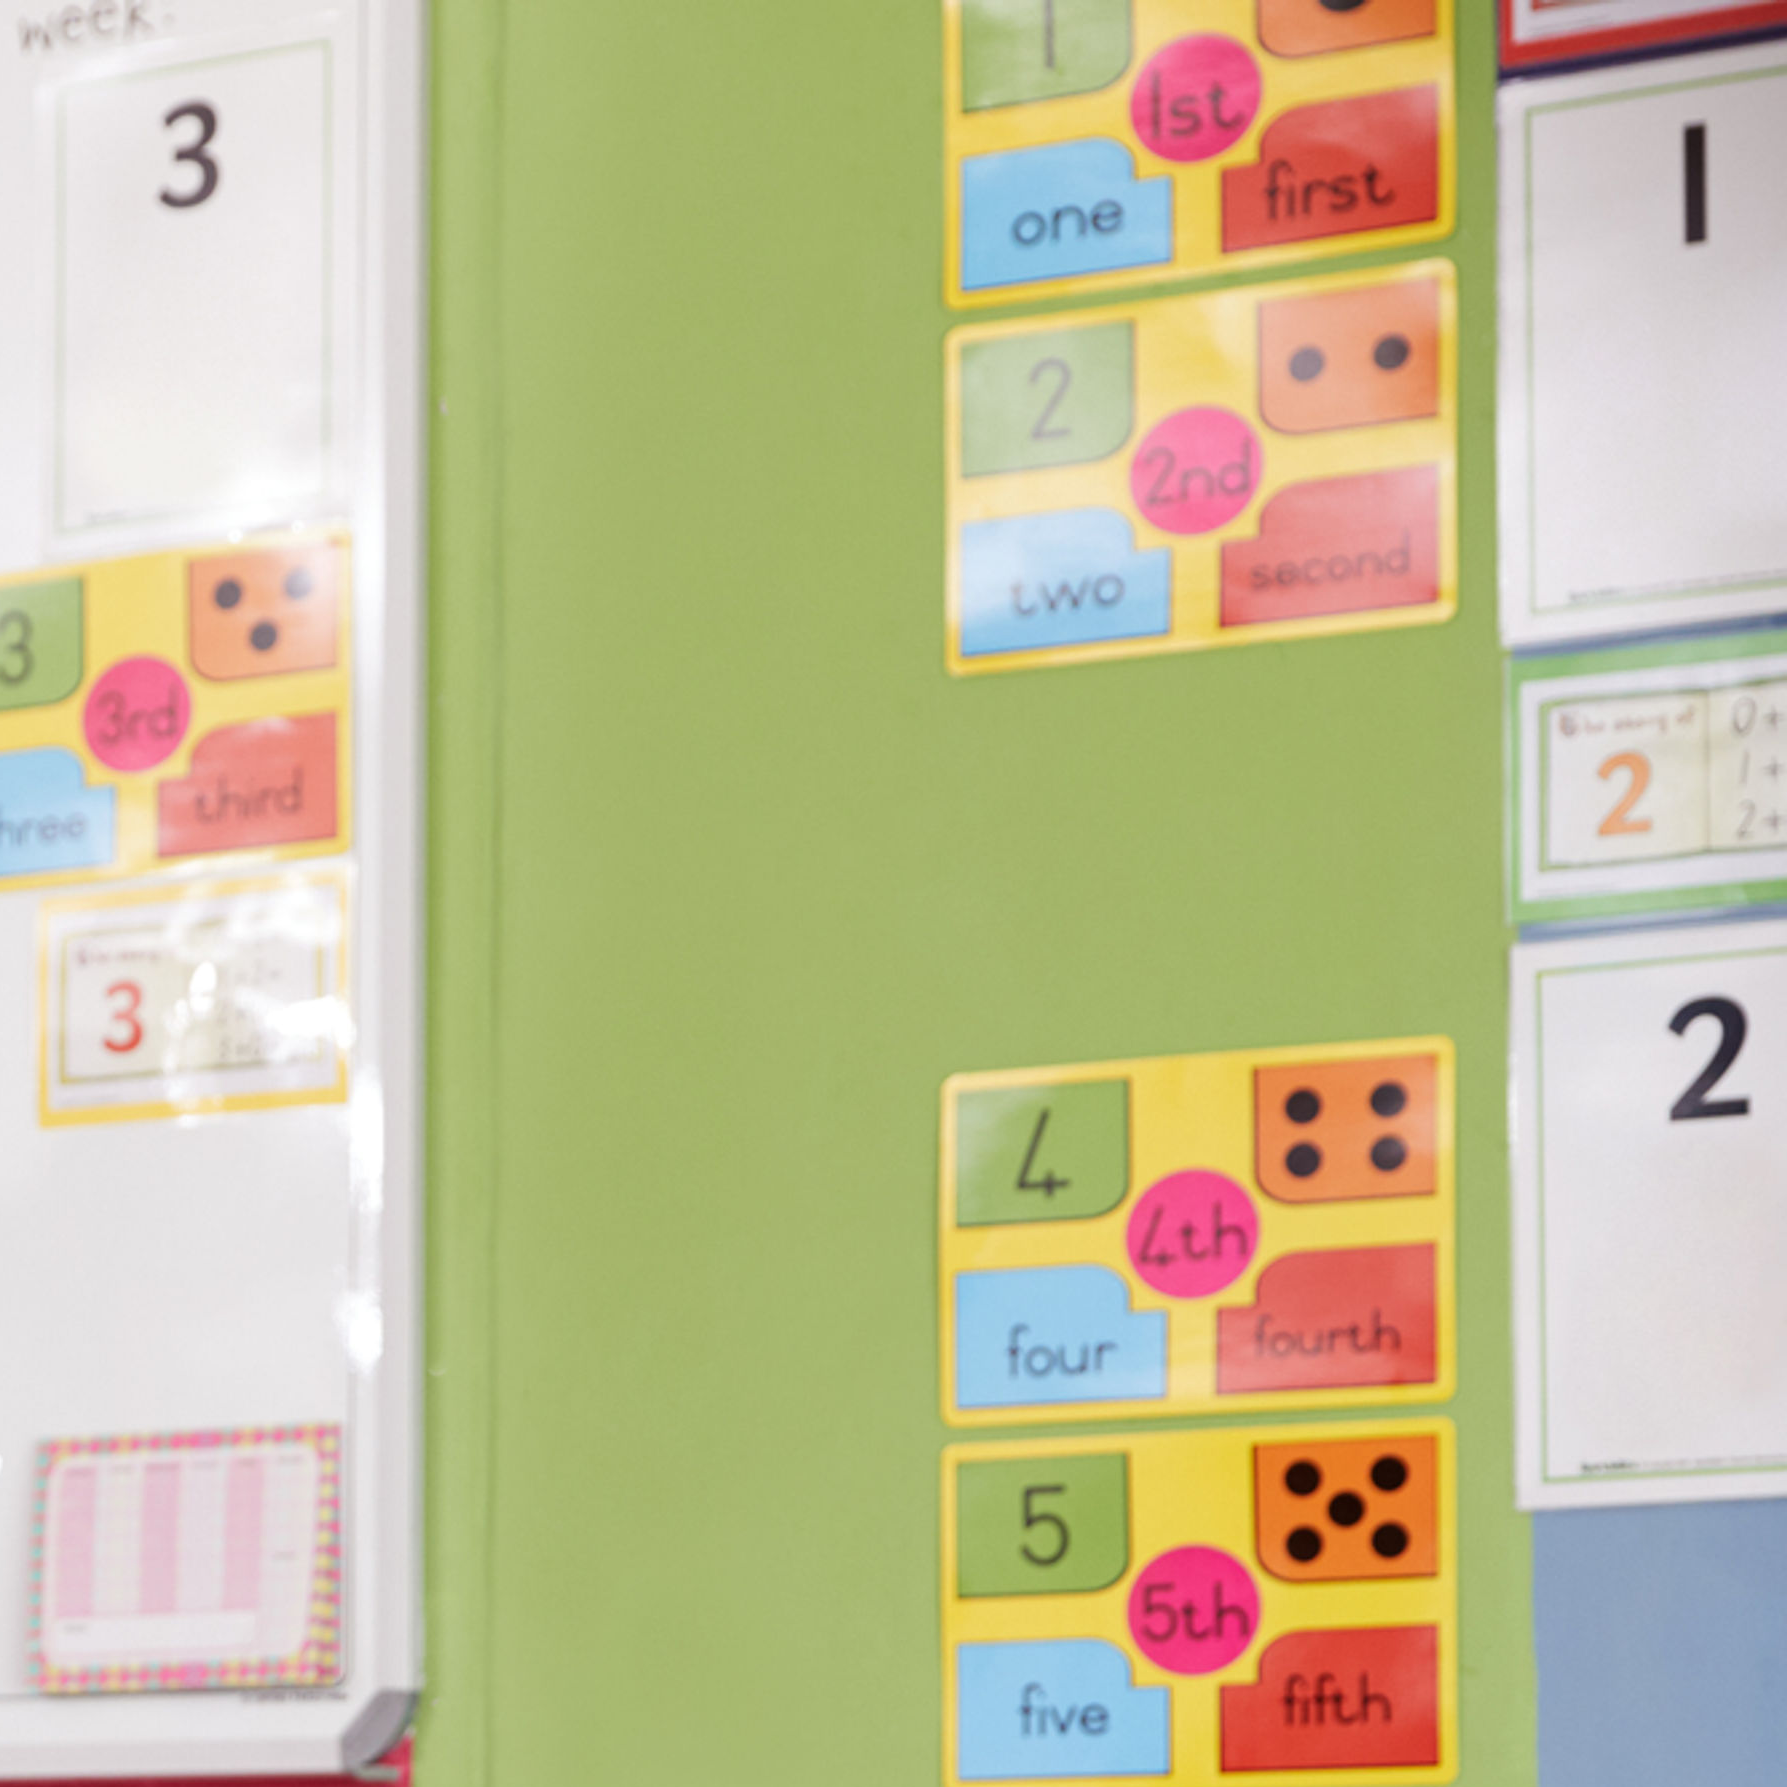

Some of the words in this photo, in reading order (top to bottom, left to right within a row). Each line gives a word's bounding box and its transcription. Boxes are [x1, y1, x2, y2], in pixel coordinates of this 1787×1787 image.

[158, 98, 222, 209] 3
[1010, 197, 1126, 249] one
[1262, 158, 1396, 224] first
[1027, 356, 1072, 442] 2
[1143, 436, 1255, 509] 2nd
[1009, 571, 1128, 618] two
[1249, 530, 1413, 594] second
[93, 684, 181, 749] 3rd
[192, 767, 307, 826] third
[1597, 750, 1653, 838] 2
[102, 978, 145, 1055] 3
[1667, 992, 1751, 1123] 2
[1015, 1106, 1073, 1199] 4
[1138, 1200, 1249, 1268] 4th
[1006, 1322, 1119, 1381] four
[1251, 1306, 1403, 1362] fourth
[1019, 1484, 1071, 1568] 5
[1142, 1580, 1251, 1644] 5th
[1016, 1682, 1111, 1737] five
[1283, 1671, 1394, 1728] fifth
